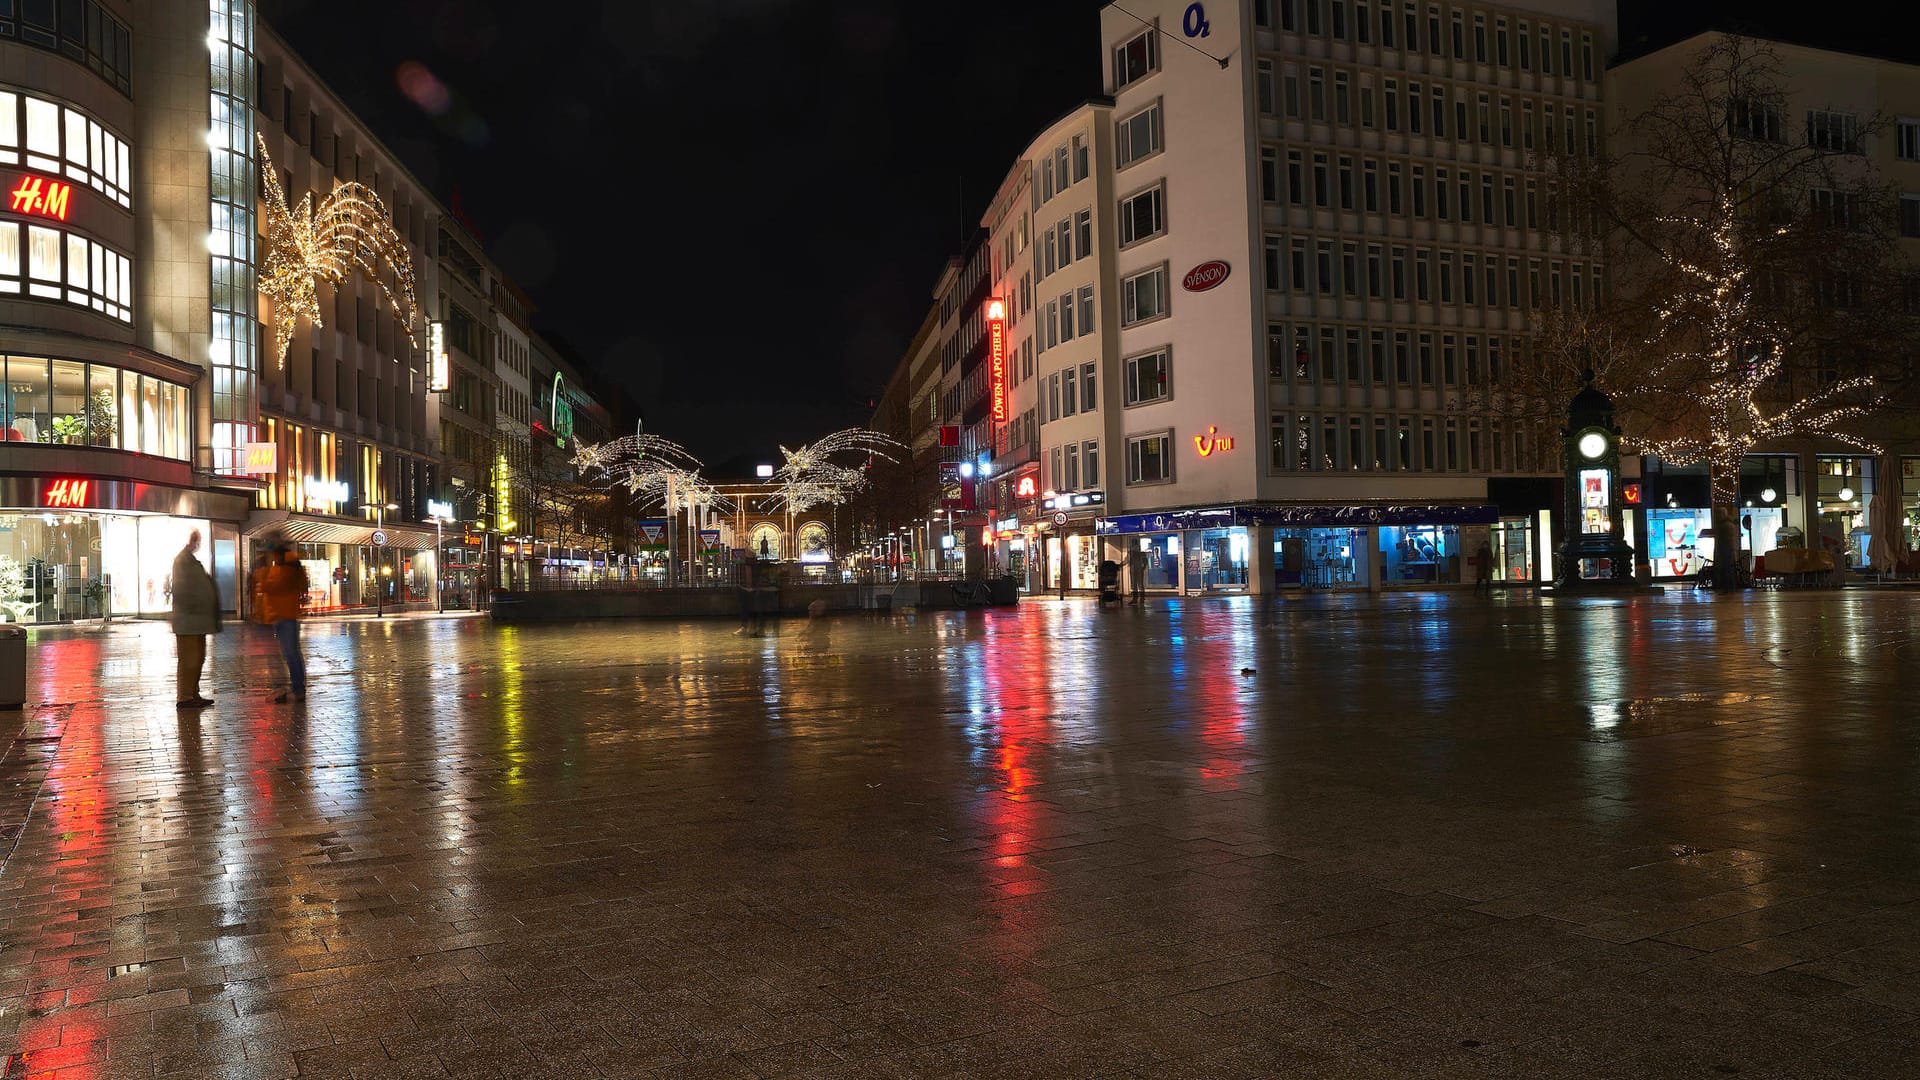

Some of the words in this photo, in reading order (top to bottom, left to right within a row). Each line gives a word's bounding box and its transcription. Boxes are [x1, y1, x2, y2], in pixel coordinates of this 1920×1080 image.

[11, 176, 70, 221] H&M
[1185, 265, 1223, 288] SVENSON
[992, 323, 1005, 420] LÖWEN-APOTHEKE
[247, 448, 274, 467] H&M
[1216, 438, 1231, 451] TUI
[47, 479, 89, 508] H&M
